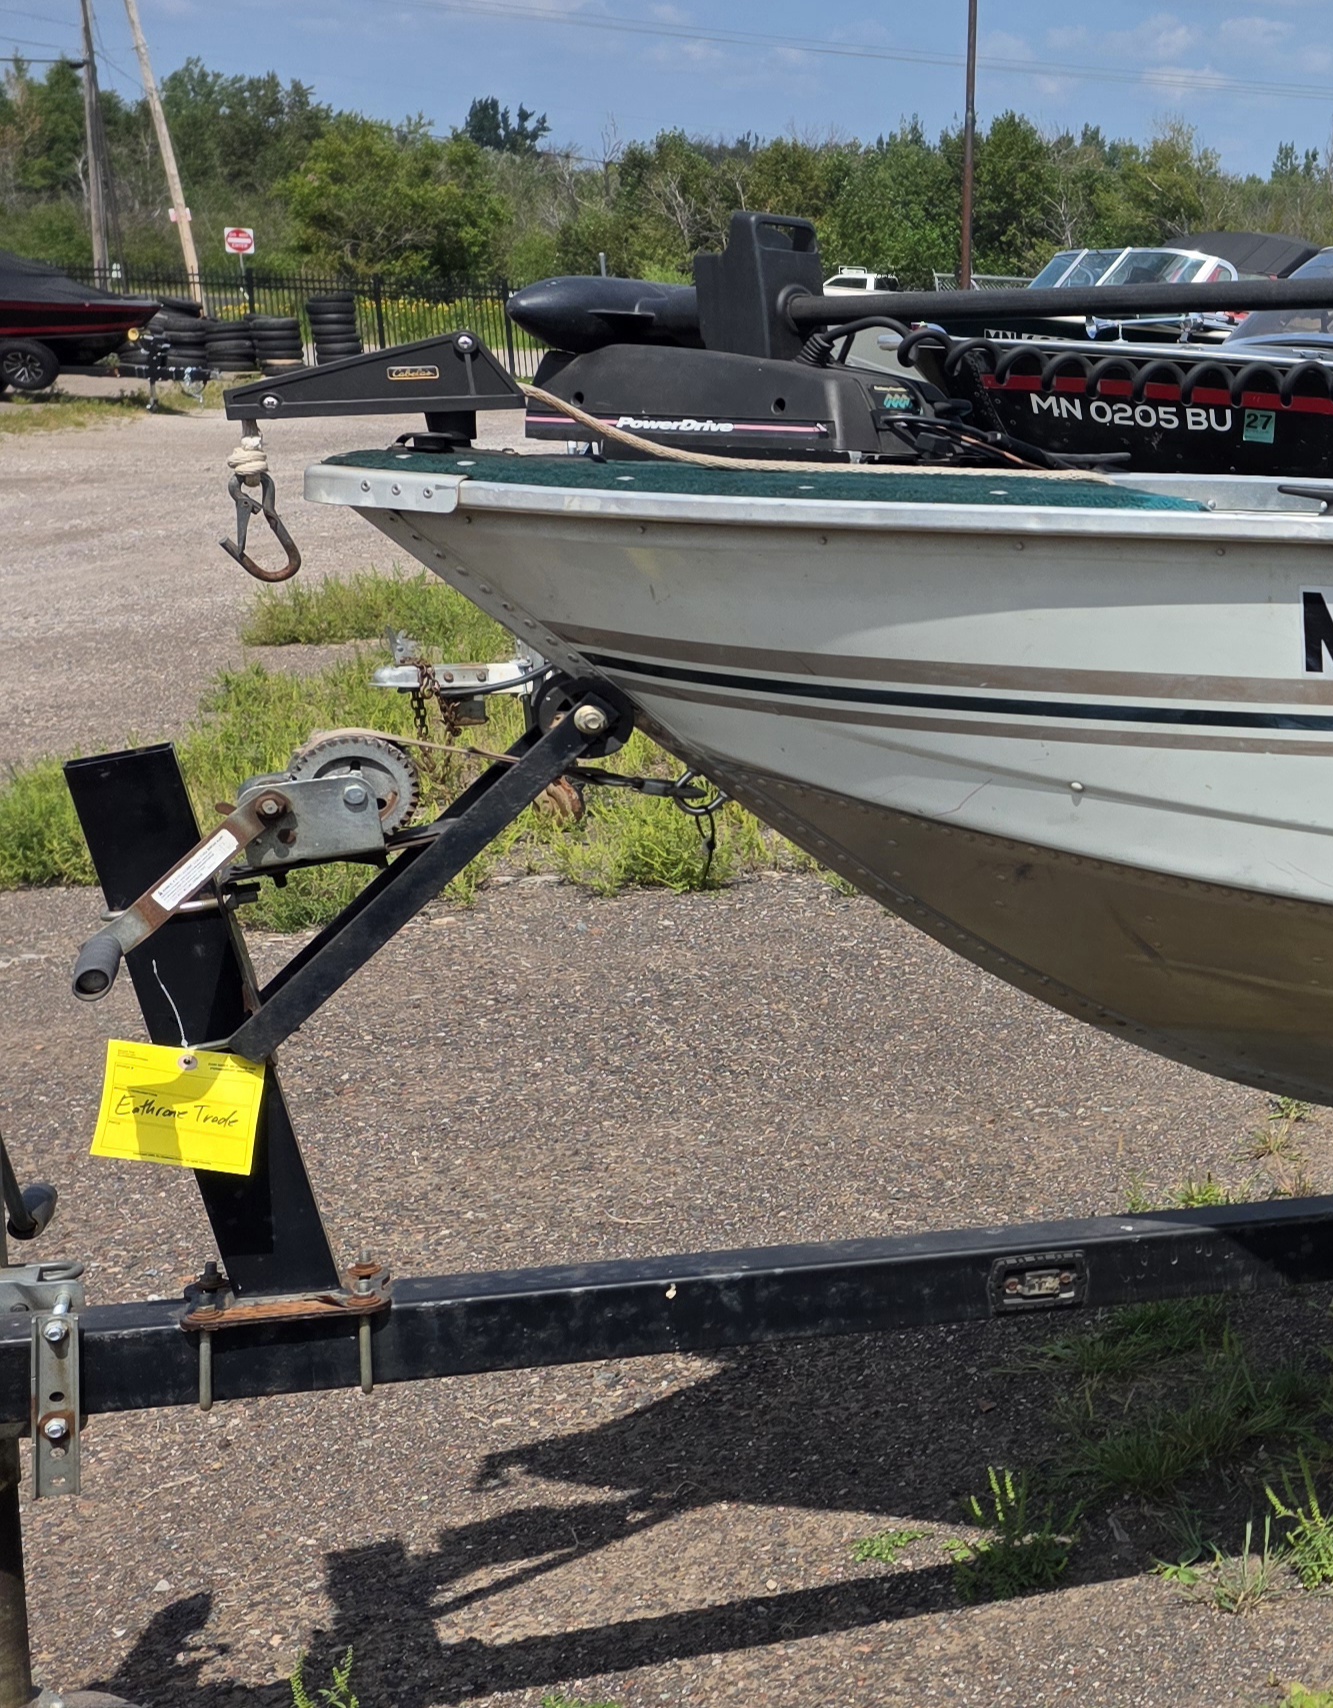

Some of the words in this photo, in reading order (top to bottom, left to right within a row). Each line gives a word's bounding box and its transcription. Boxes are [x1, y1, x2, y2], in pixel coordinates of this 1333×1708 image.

[1030, 393, 1082, 420] MN
[1089, 400, 1180, 429] 0205
[1186, 408, 1233, 432] BU
[1245, 412, 1273, 430] 27
[616, 416, 734, 432] PowerDrive
